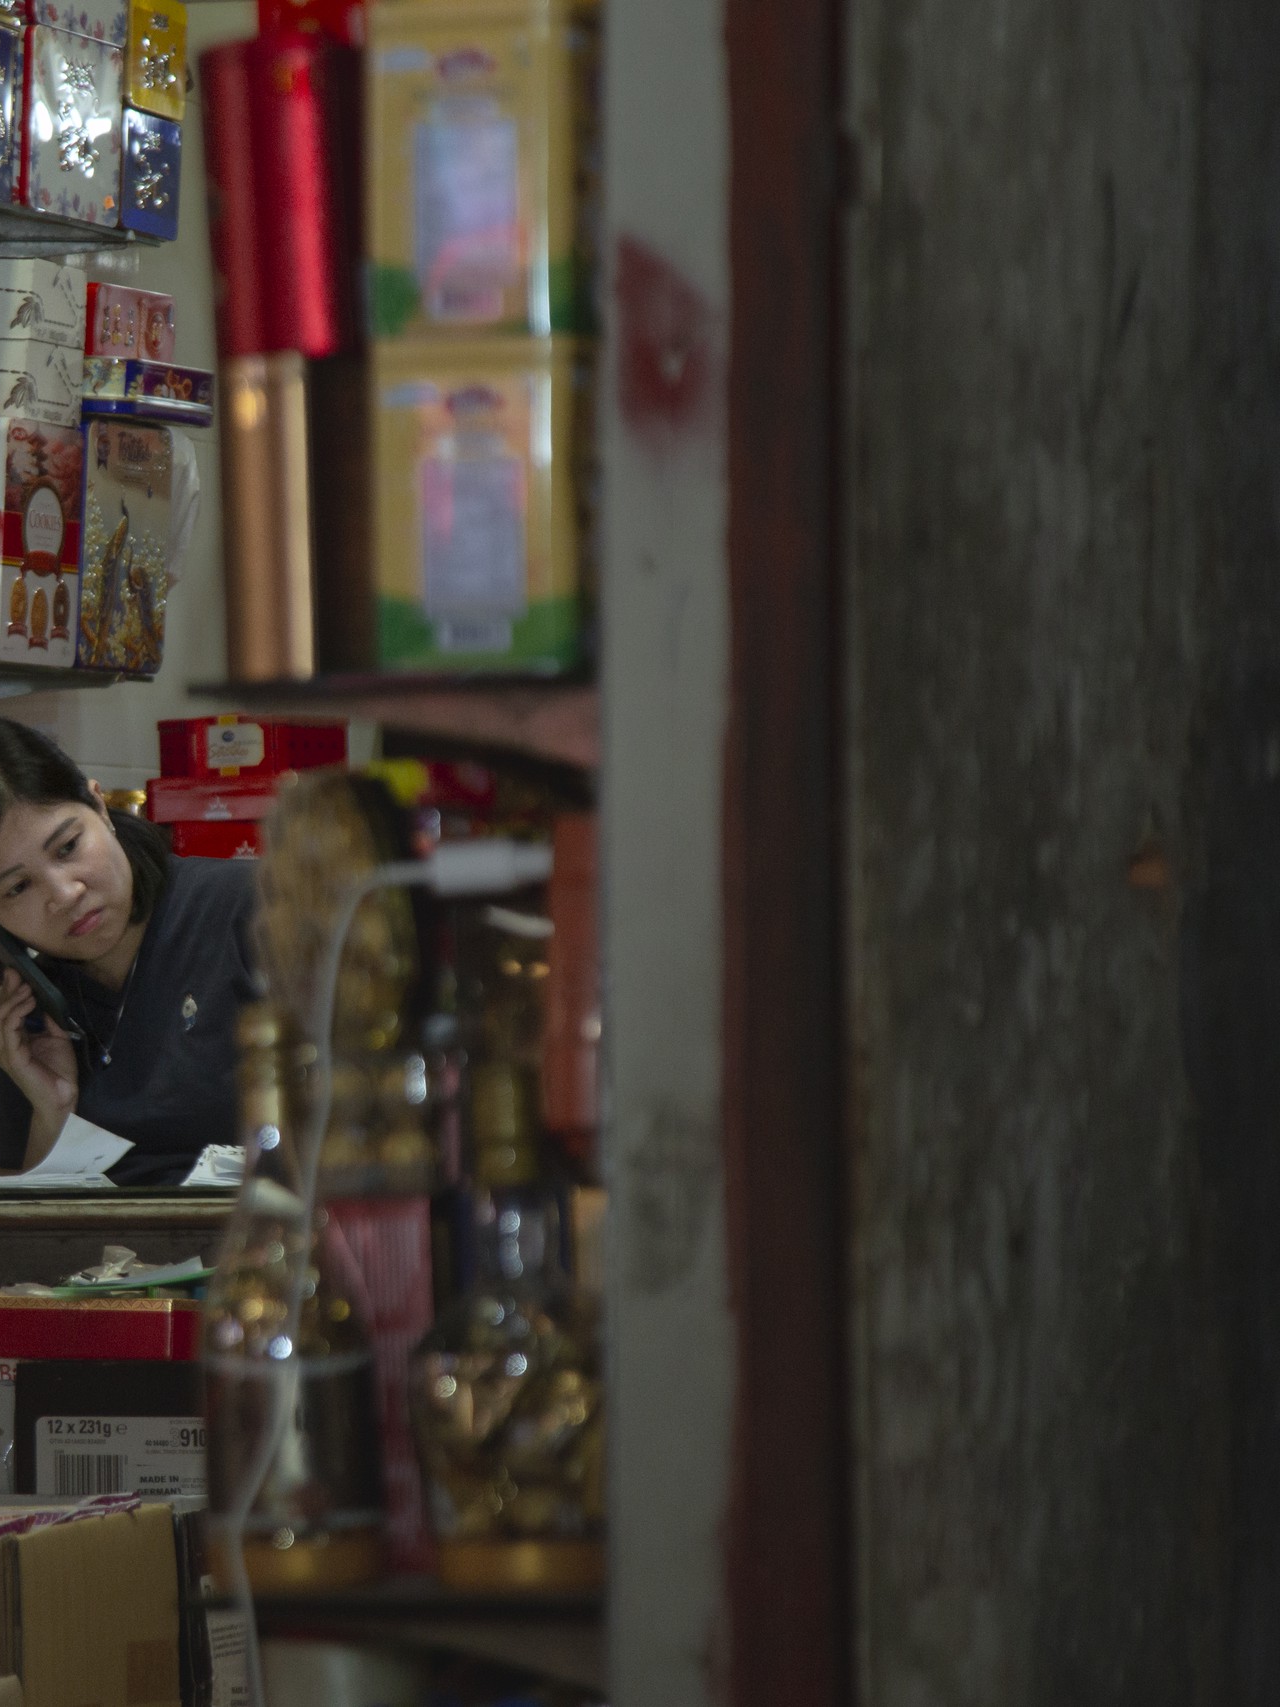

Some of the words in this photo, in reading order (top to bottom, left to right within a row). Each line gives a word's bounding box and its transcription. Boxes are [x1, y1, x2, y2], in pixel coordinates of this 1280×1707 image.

[47, 1419, 64, 1436] 12
[66, 1423, 78, 1436] x
[78, 1418, 112, 1439] 231g
[139, 1475, 166, 1484] MADE
[168, 1474, 180, 1484] IN
